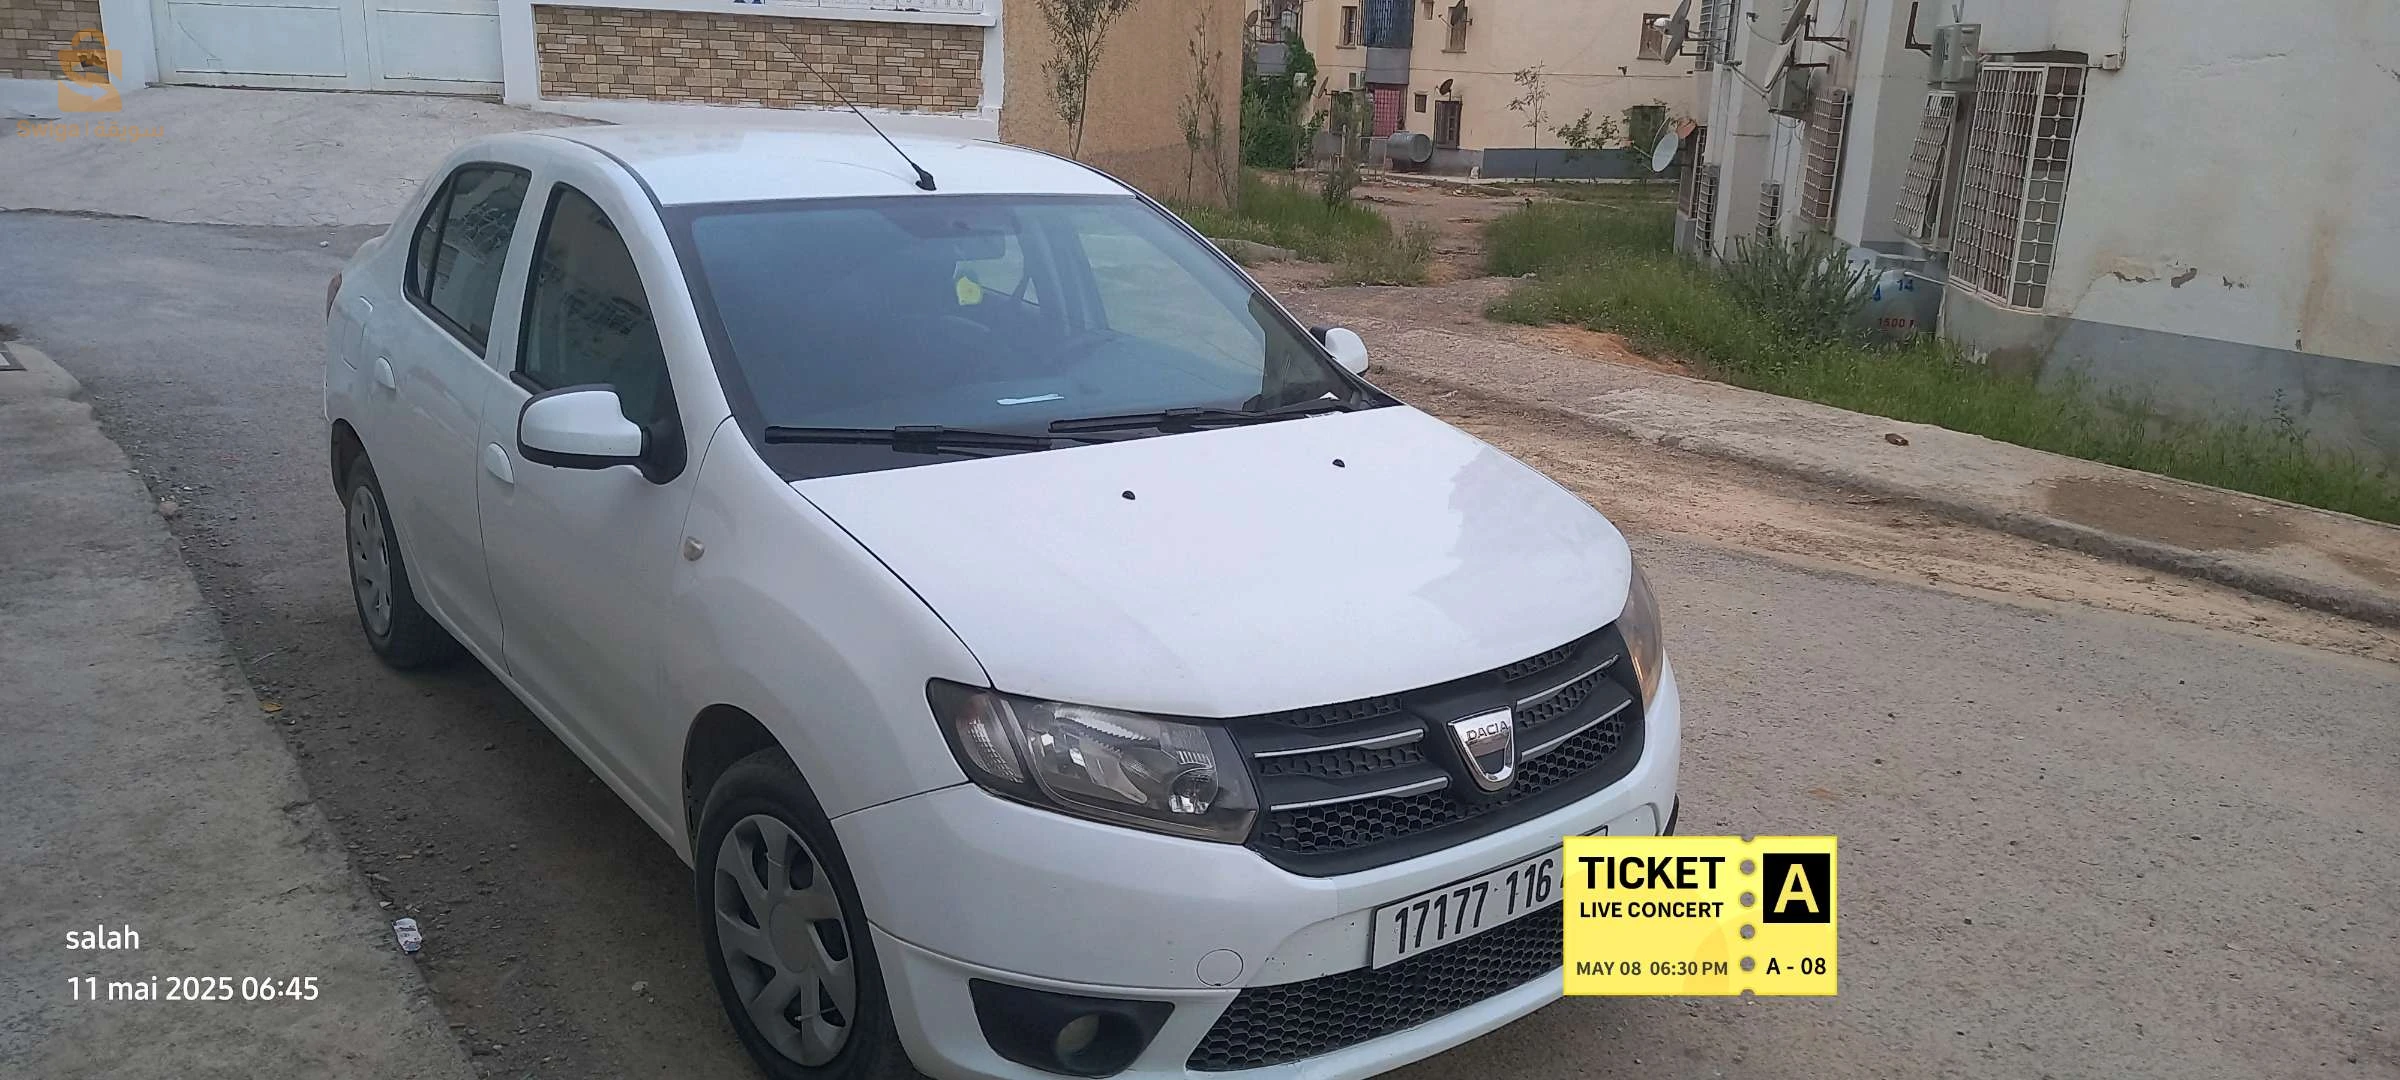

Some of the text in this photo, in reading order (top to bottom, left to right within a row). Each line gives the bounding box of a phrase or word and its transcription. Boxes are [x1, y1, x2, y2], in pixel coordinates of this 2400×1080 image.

[1466, 720, 1509, 741] DACIA
[1395, 858, 1554, 955] 17177 116
